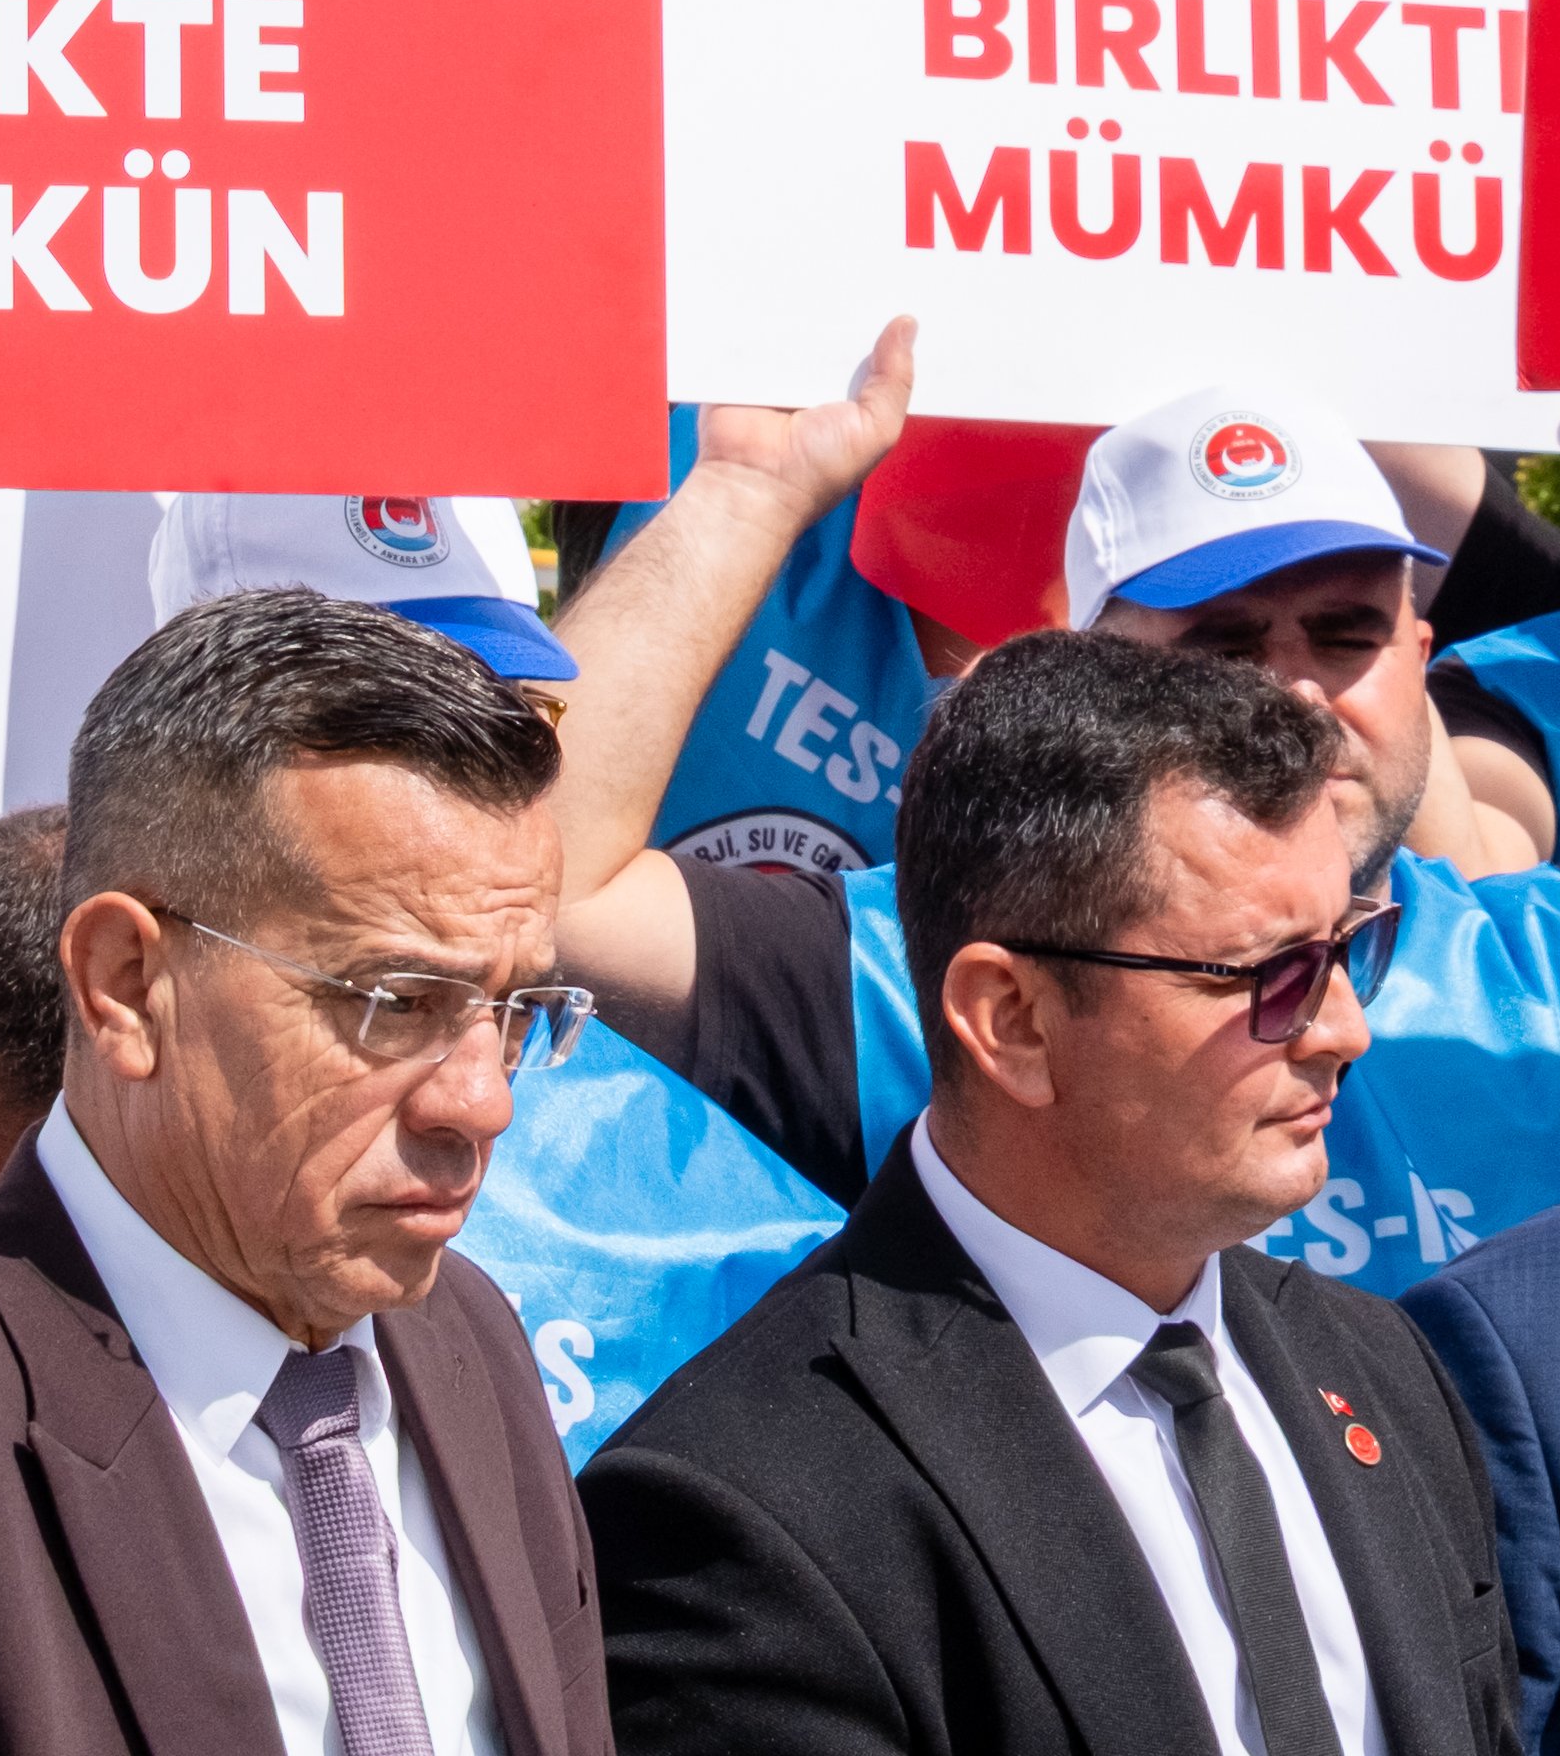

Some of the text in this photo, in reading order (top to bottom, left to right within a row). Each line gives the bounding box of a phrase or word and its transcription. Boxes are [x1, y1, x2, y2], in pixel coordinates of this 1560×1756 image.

[904, 117, 1504, 282] MÜMKÜ
[746, 647, 902, 804] TES-
[747, 828, 776, 853] SU
[783, 828, 810, 857] VE
